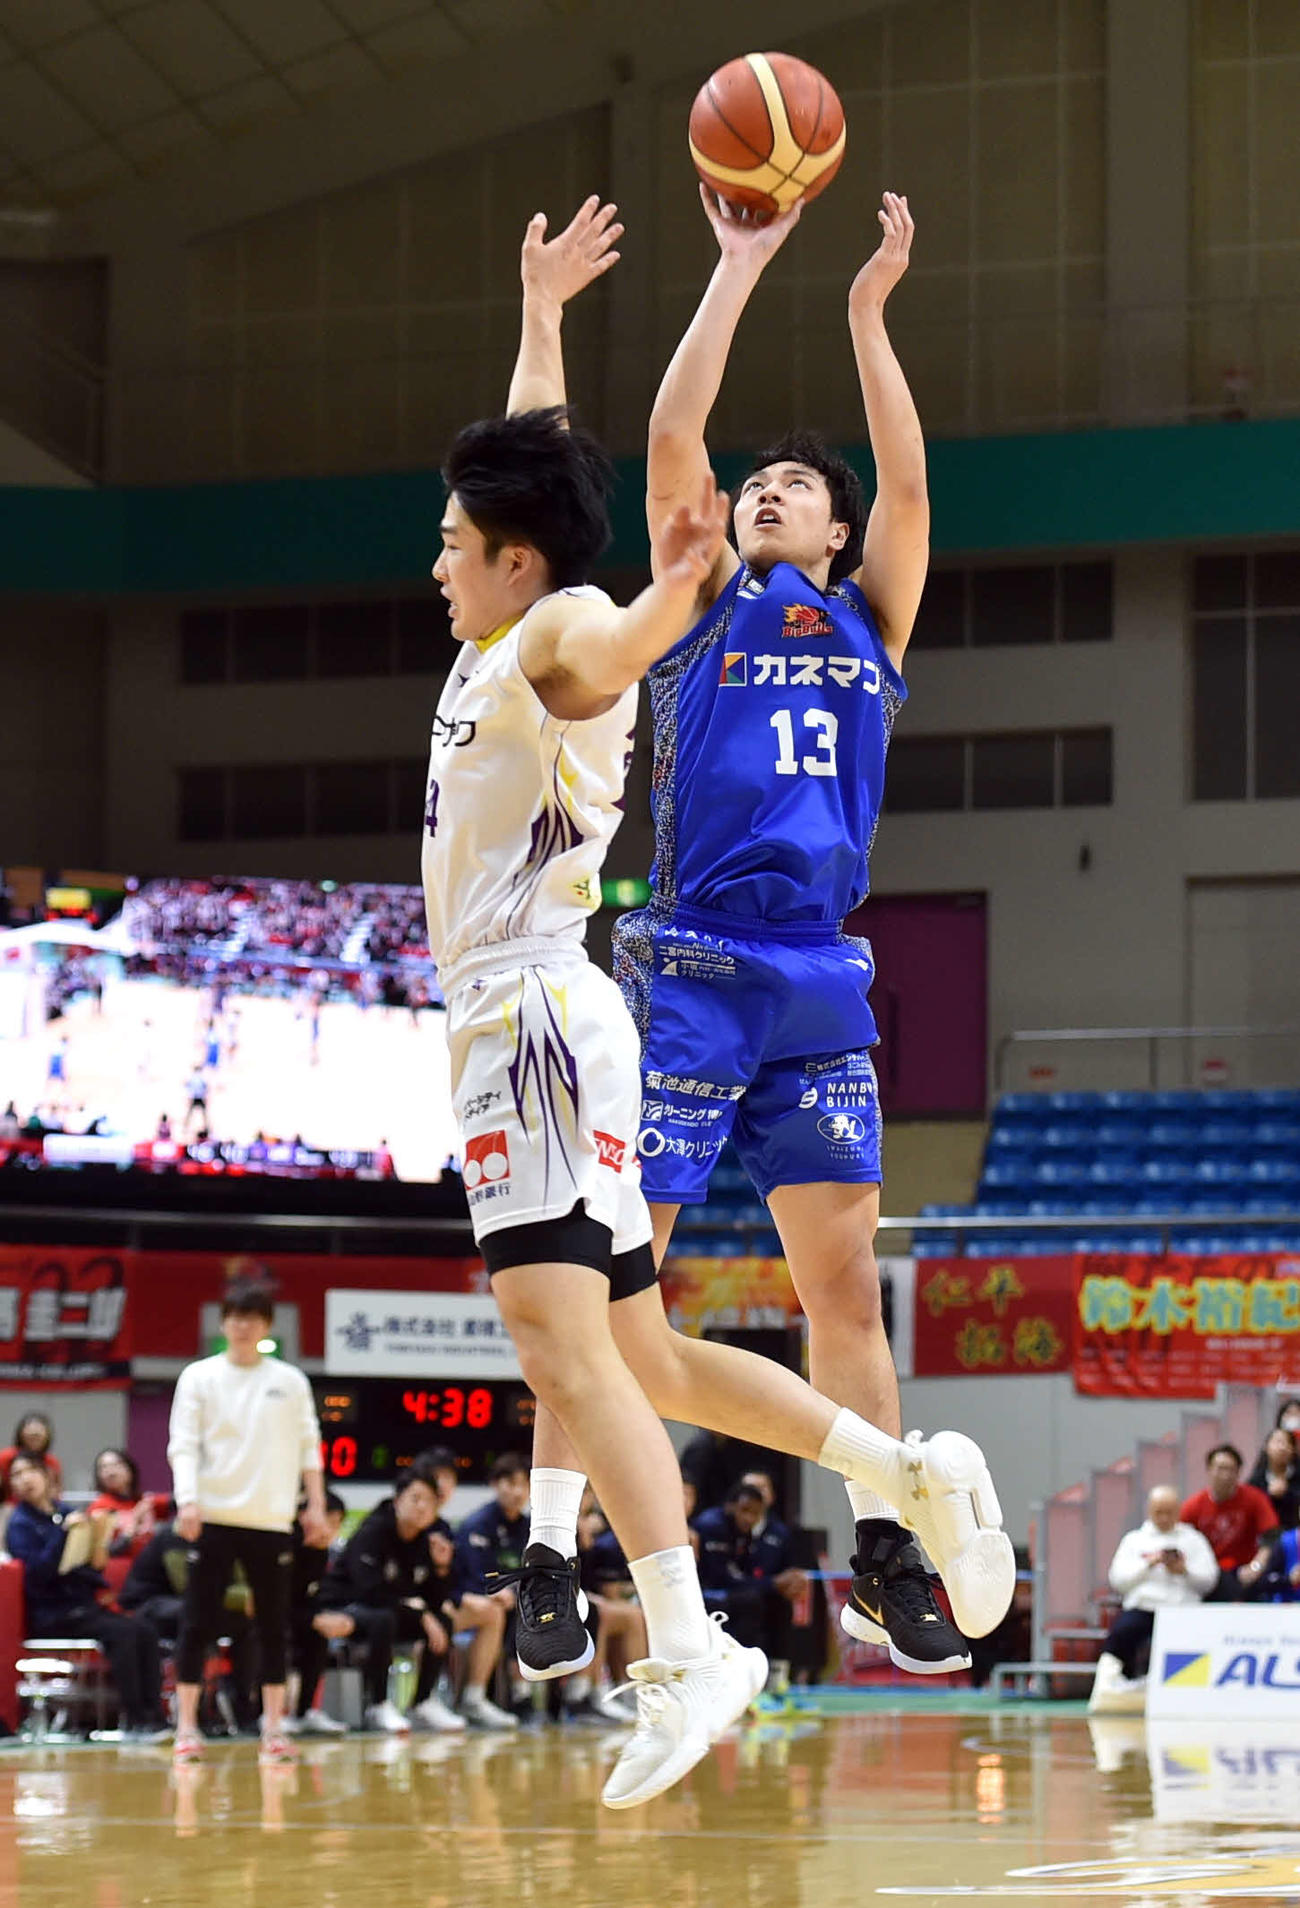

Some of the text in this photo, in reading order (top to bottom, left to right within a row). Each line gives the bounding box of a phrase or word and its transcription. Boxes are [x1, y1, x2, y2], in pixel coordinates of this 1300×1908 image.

[769, 708, 839, 777] 13
[826, 1096, 867, 1108] BIJIN
[402, 1387, 493, 1429] 4:38
